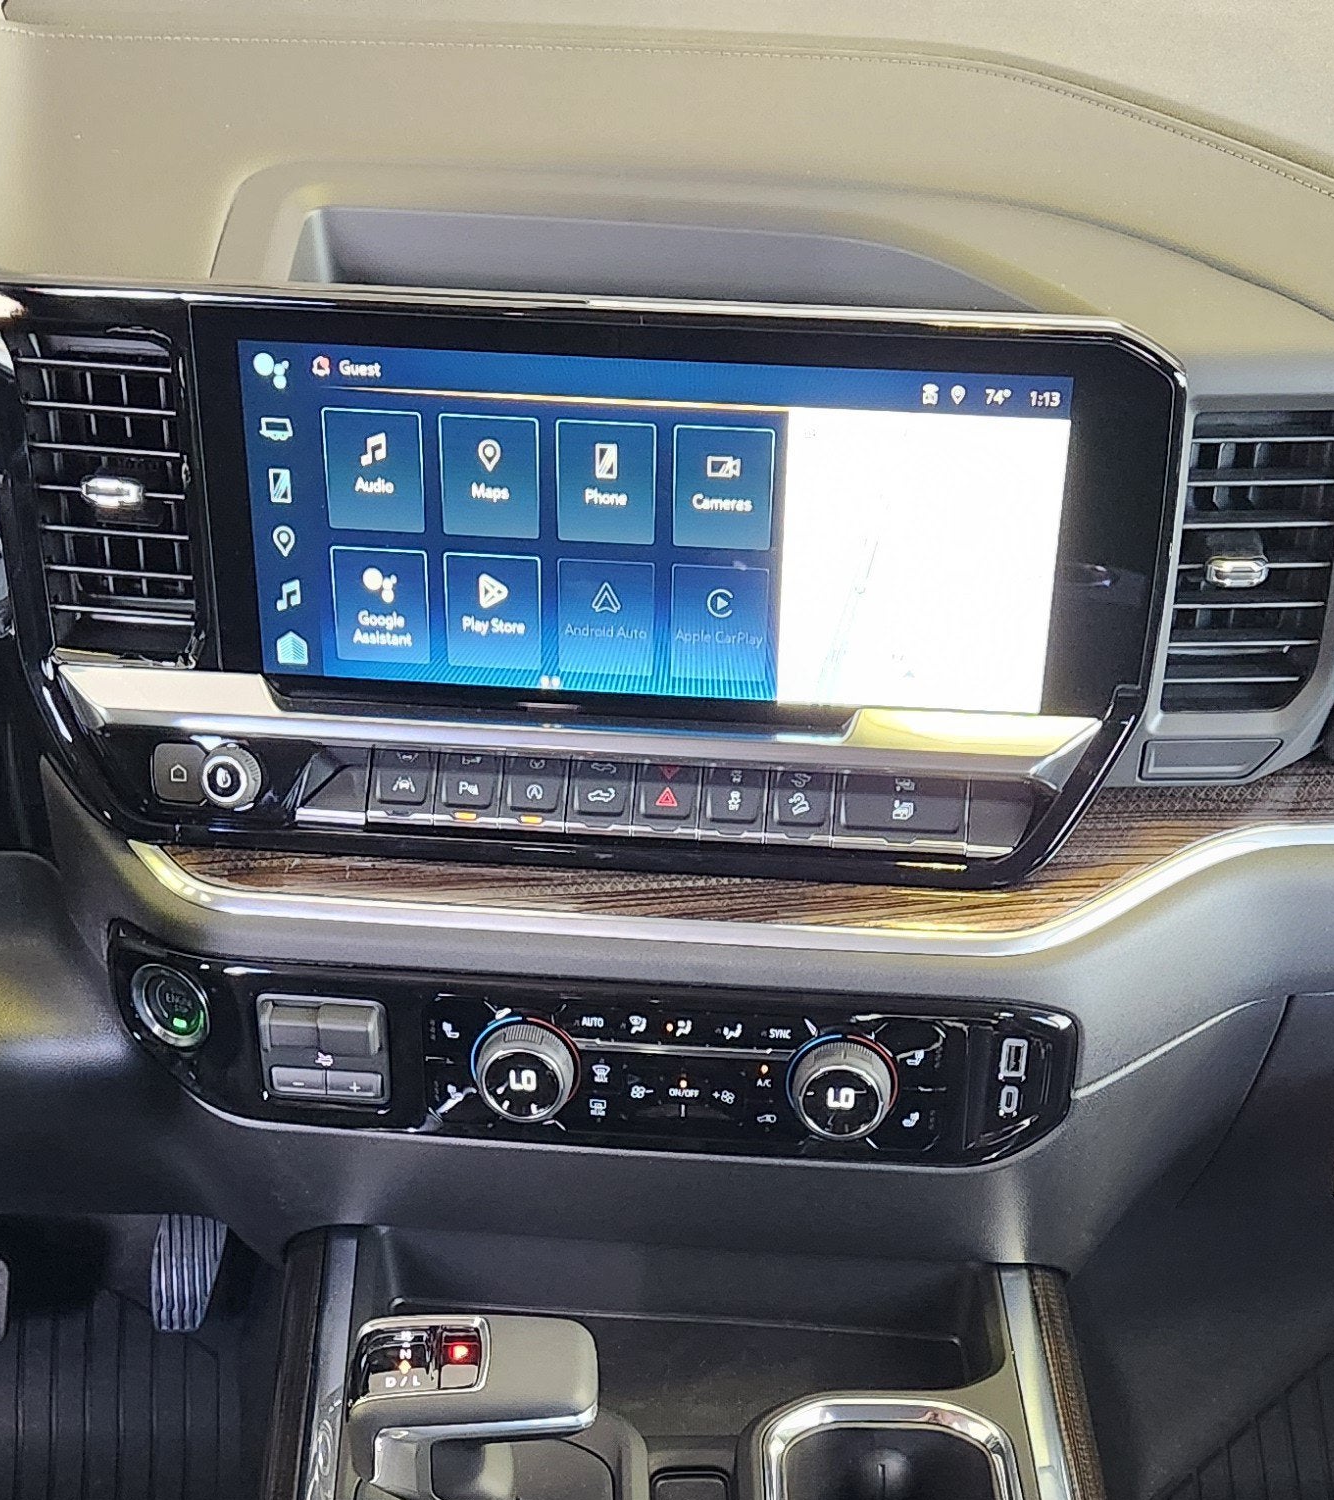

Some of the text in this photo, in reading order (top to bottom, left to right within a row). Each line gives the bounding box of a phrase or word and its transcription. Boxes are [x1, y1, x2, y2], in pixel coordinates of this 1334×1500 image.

[339, 359, 382, 378] Guest
[1030, 390, 1061, 407] 1:13
[354, 477, 394, 495] Audio
[471, 482, 510, 502] Maps
[584, 488, 627, 506] Phone
[692, 493, 753, 512] Cameras
[358, 610, 405, 631] Google
[462, 616, 525, 636] Play Store
[353, 628, 412, 647] Assistant
[565, 623, 647, 639] Android Auto
[676, 629, 764, 648] Apple CarPlay
[581, 1016, 604, 1028] AUTO
[769, 1028, 792, 1040] SYNC
[757, 1078, 771, 1088] A/C
[669, 1088, 699, 1098] ON/OFF
[399, 1349, 412, 1360] N
